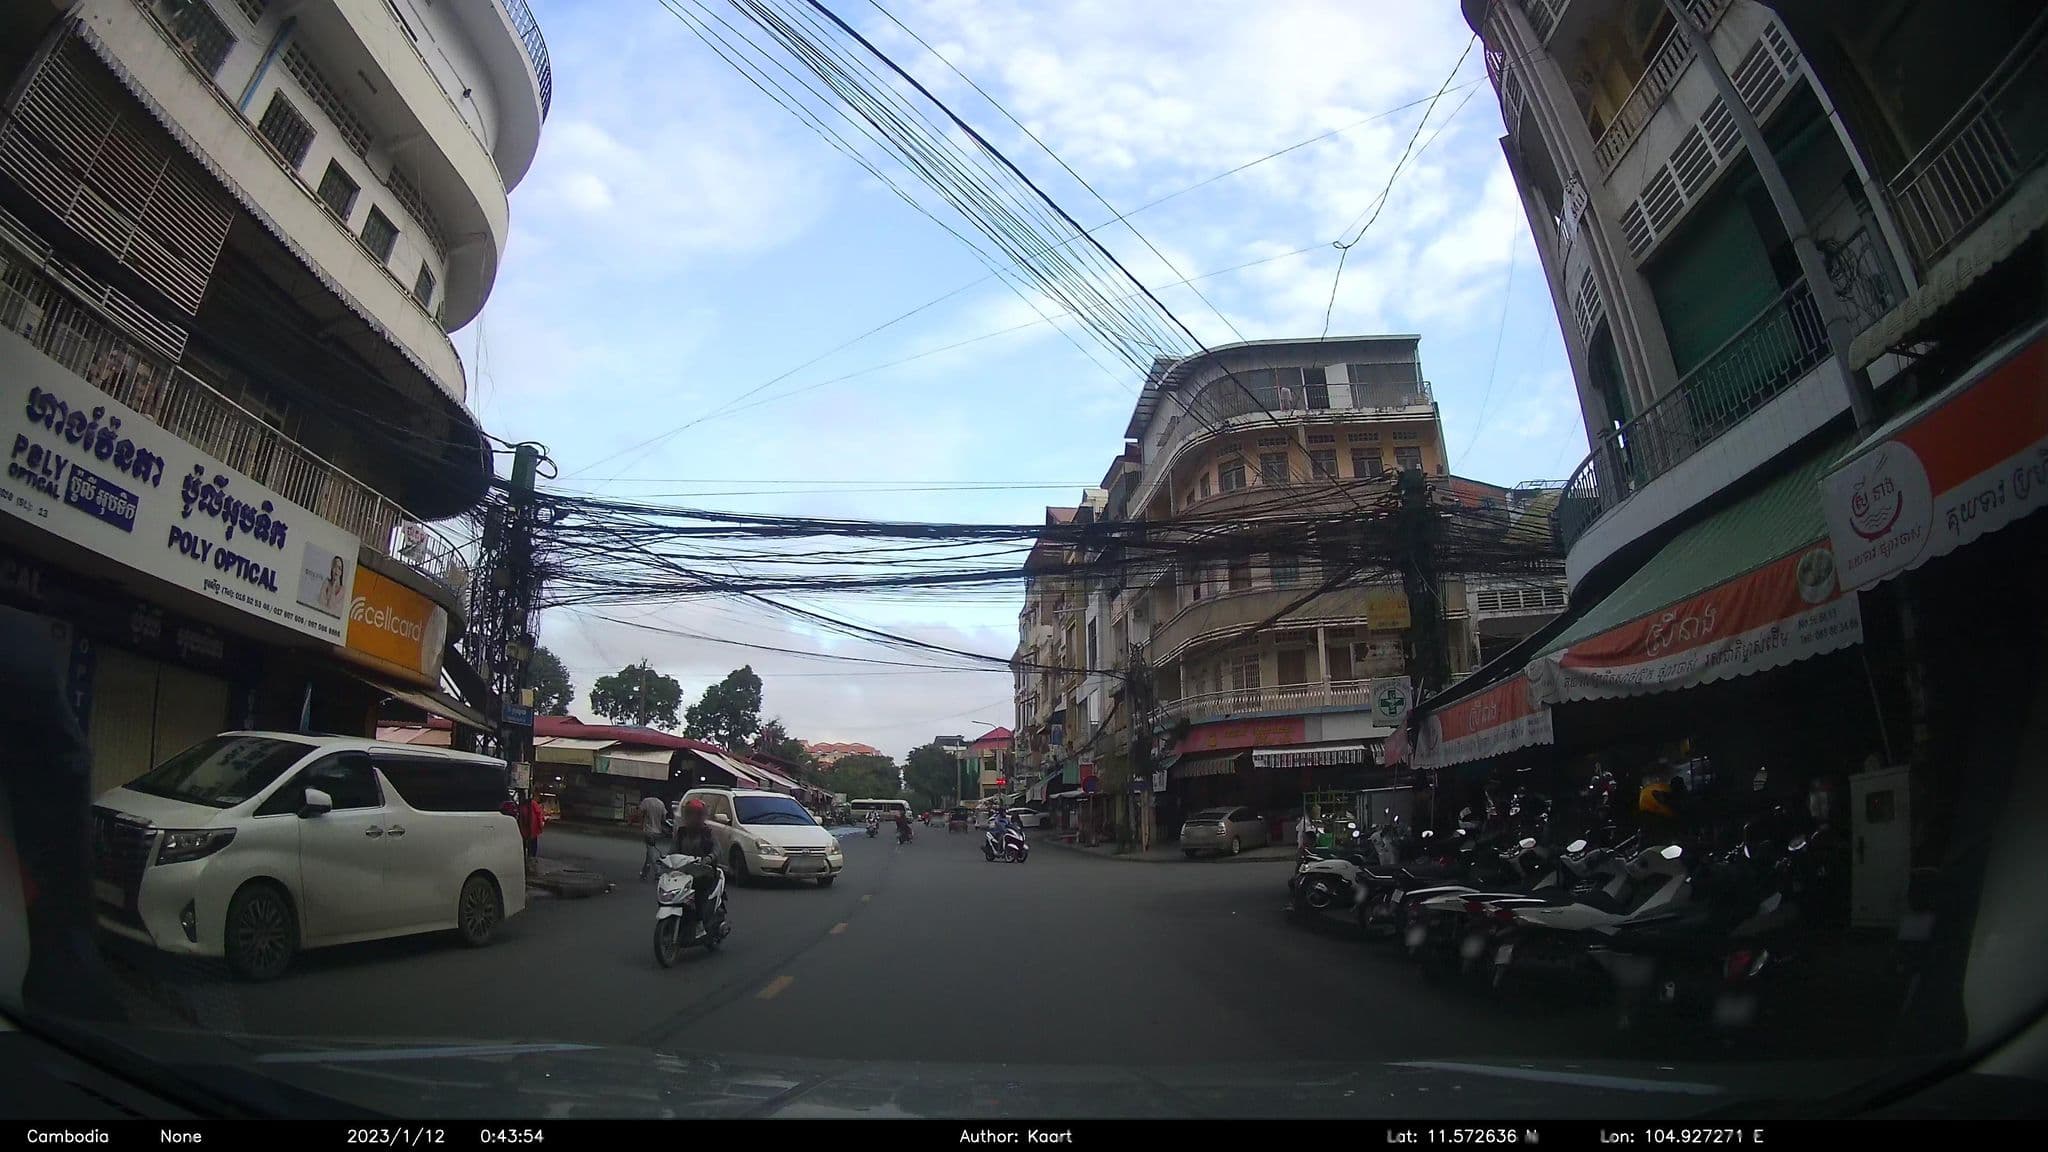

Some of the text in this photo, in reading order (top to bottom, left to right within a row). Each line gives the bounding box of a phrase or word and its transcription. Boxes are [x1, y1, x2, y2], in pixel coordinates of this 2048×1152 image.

[11, 433, 68, 481] POLY
[8, 462, 61, 500] OPTICAL
[168, 525, 279, 593] POLY OPTICAL
[364, 604, 423, 642] cellcard
